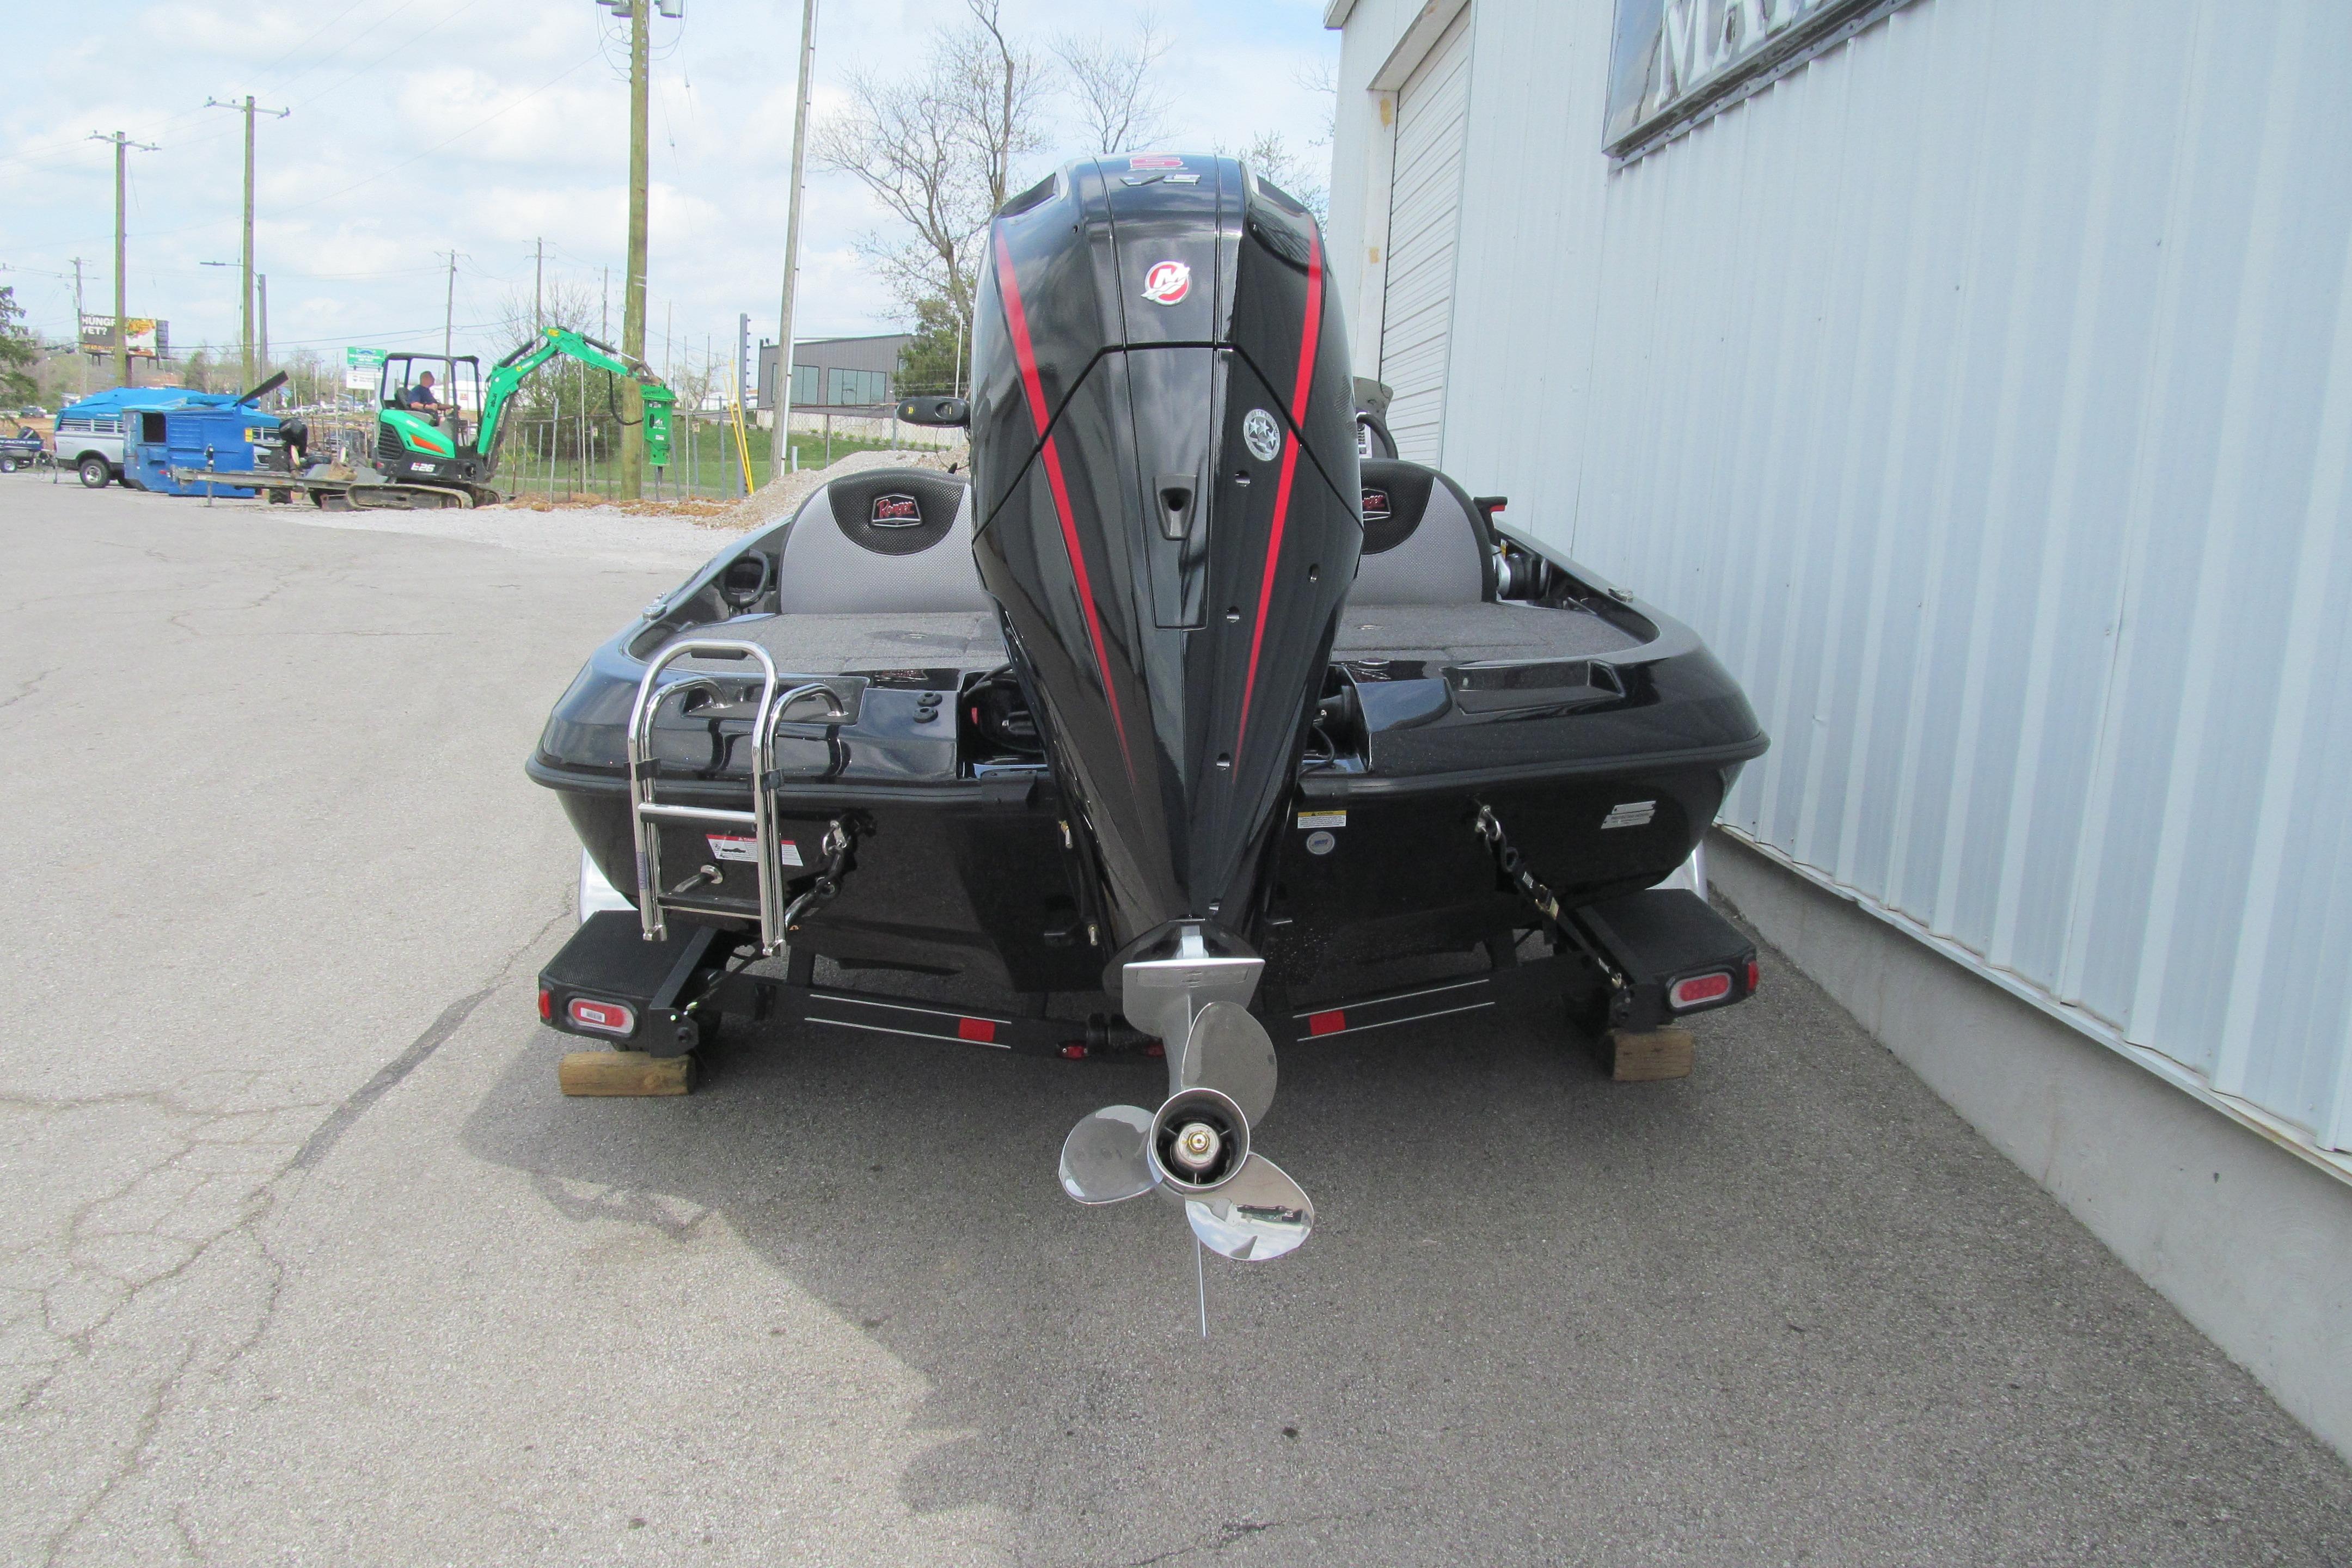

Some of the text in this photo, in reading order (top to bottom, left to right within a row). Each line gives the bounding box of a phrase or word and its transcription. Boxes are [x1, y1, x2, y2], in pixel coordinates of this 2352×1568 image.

[81, 316, 116, 327] HUNGR
[82, 326, 108, 335] YET?
[410, 462, 436, 471] E26
[877, 499, 915, 519] Ranger
